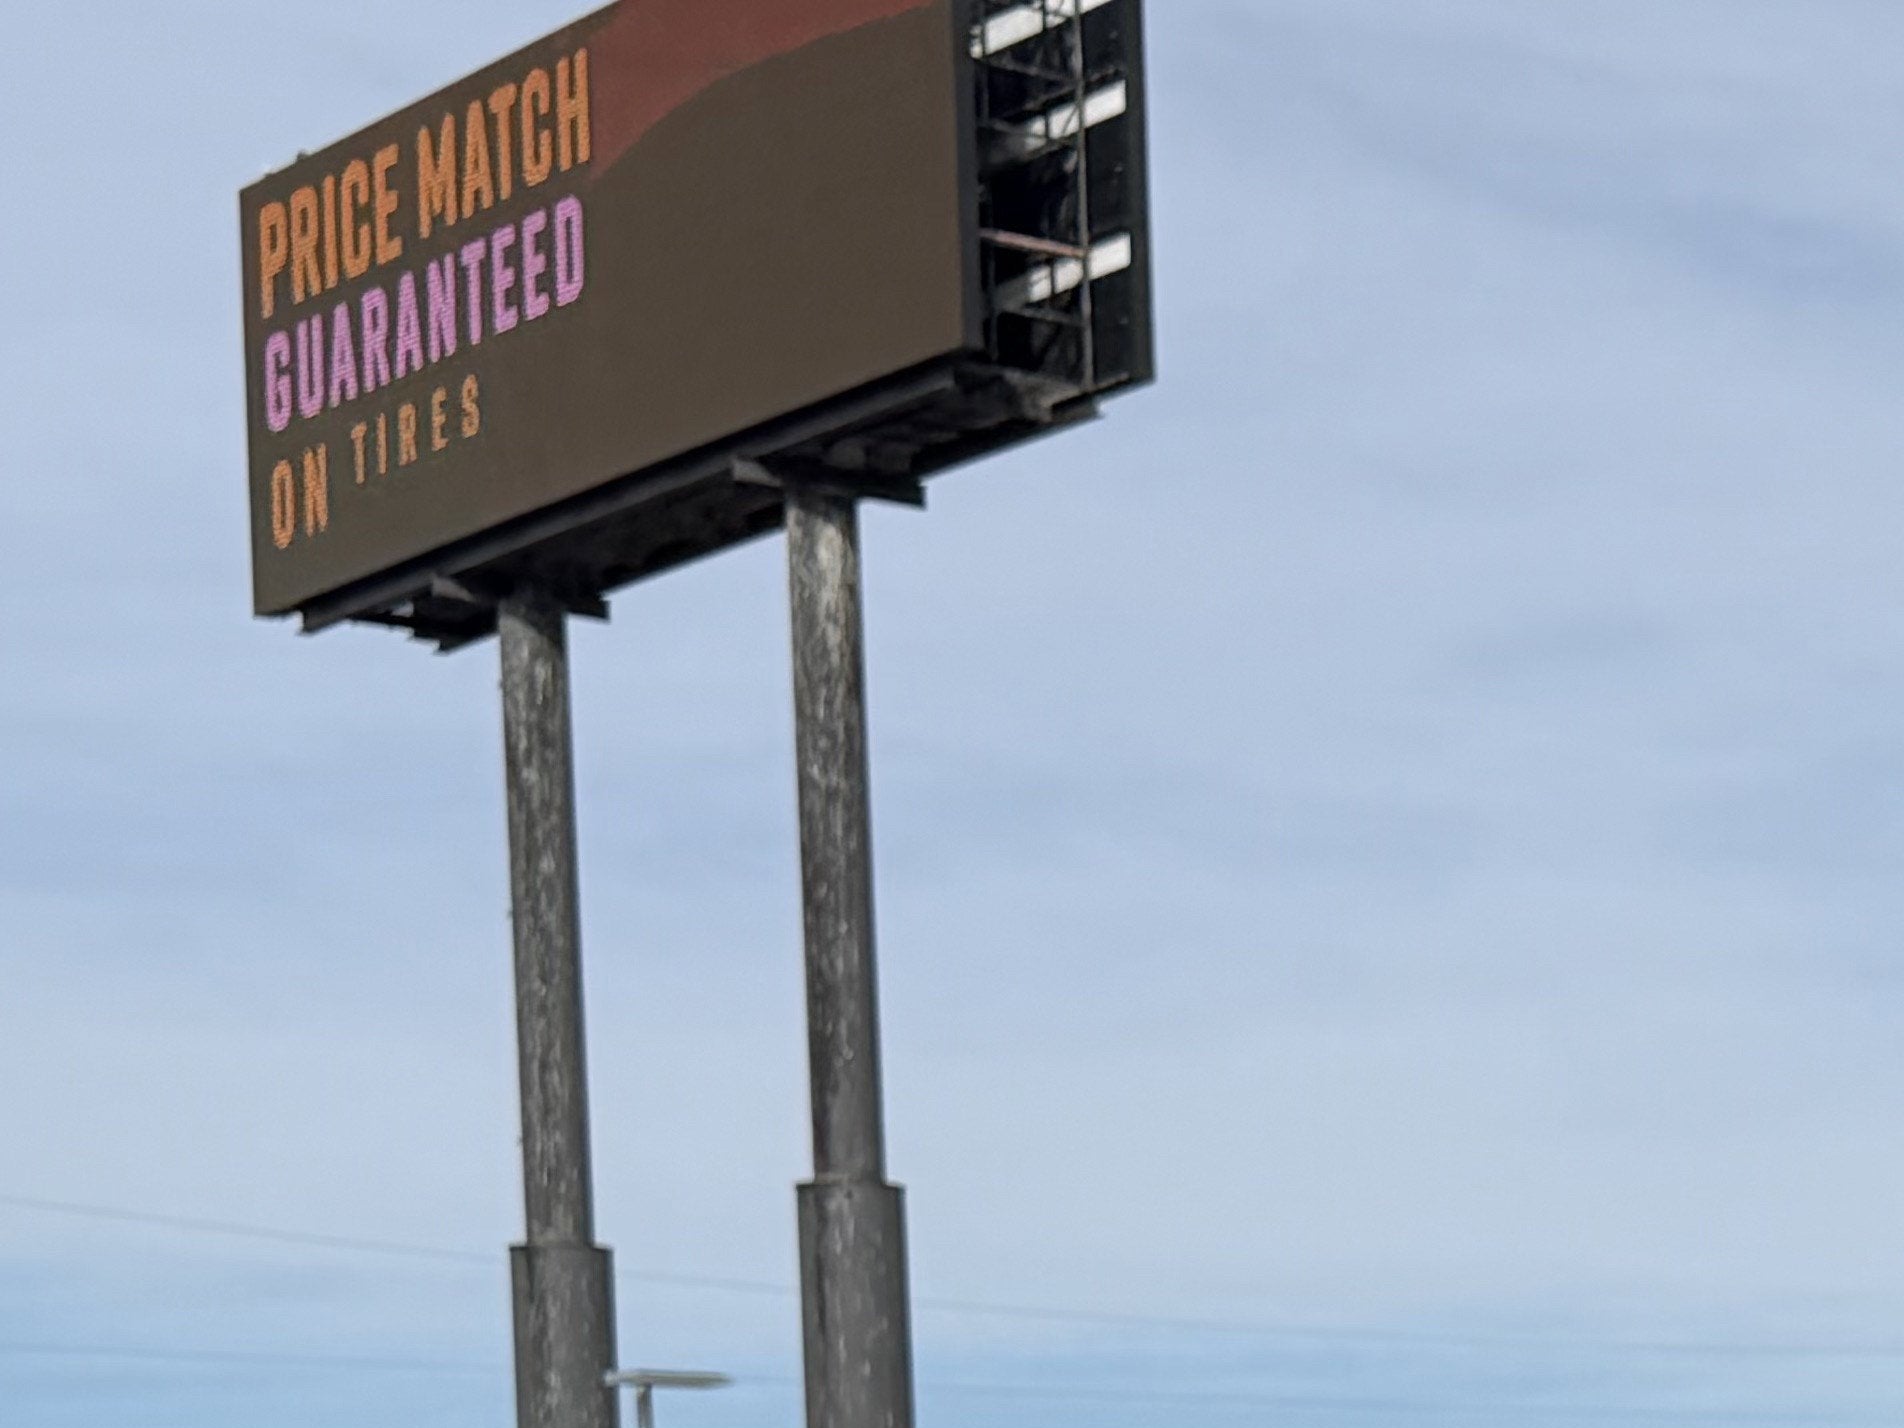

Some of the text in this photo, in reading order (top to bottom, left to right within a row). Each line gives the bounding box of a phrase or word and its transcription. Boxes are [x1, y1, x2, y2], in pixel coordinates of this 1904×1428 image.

[258, 46, 592, 319] PRICE MATCH
[263, 194, 586, 433] GUARANTEED
[270, 374, 481, 549] ON TIRES
